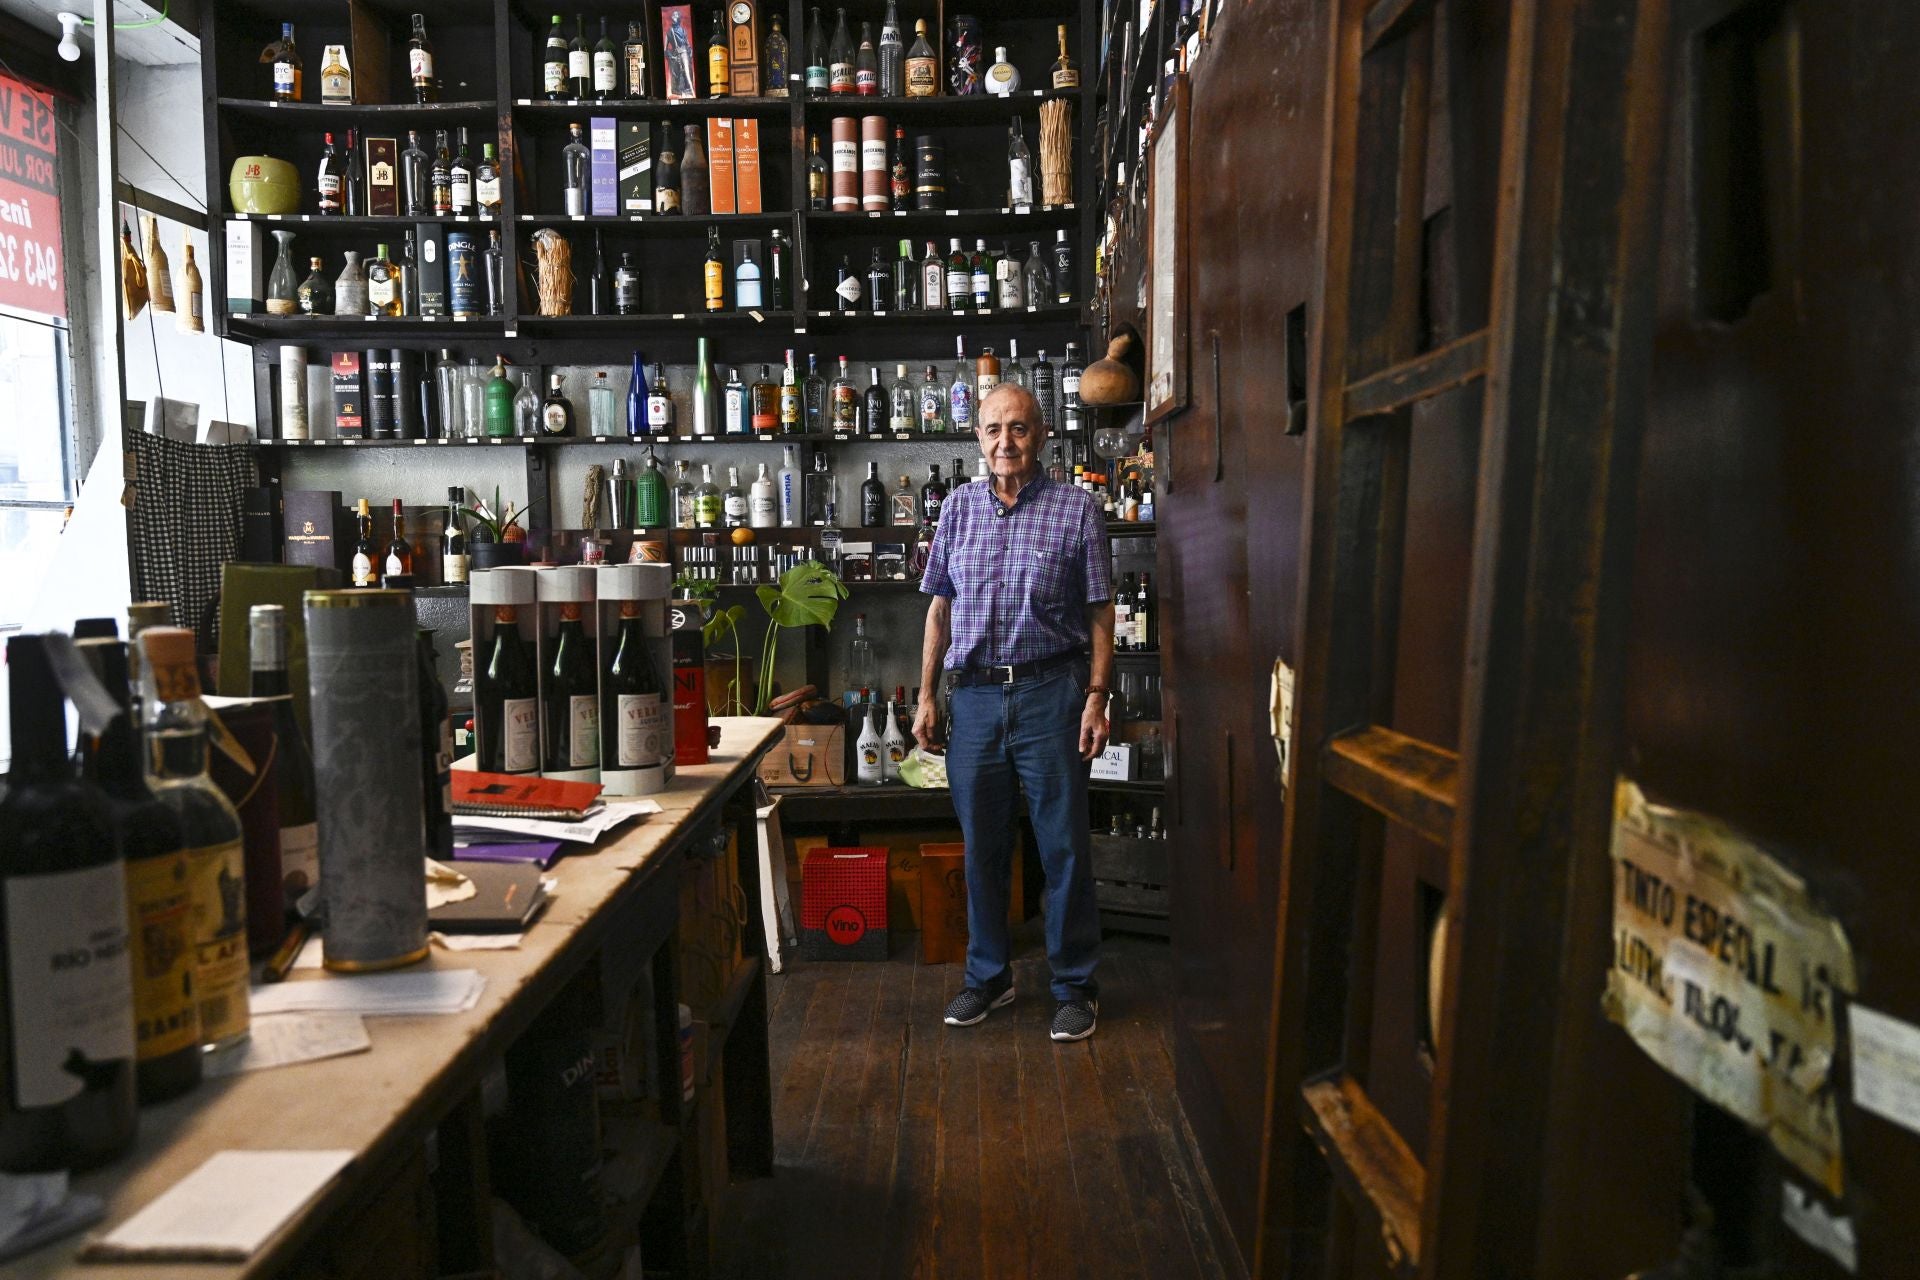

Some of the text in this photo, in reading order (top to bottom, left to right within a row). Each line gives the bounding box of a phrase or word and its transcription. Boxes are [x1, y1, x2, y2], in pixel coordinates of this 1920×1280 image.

[246, 165, 261, 176] J&B
[376, 170, 391, 181] J&B
[447, 241, 477, 253] DINGLE
